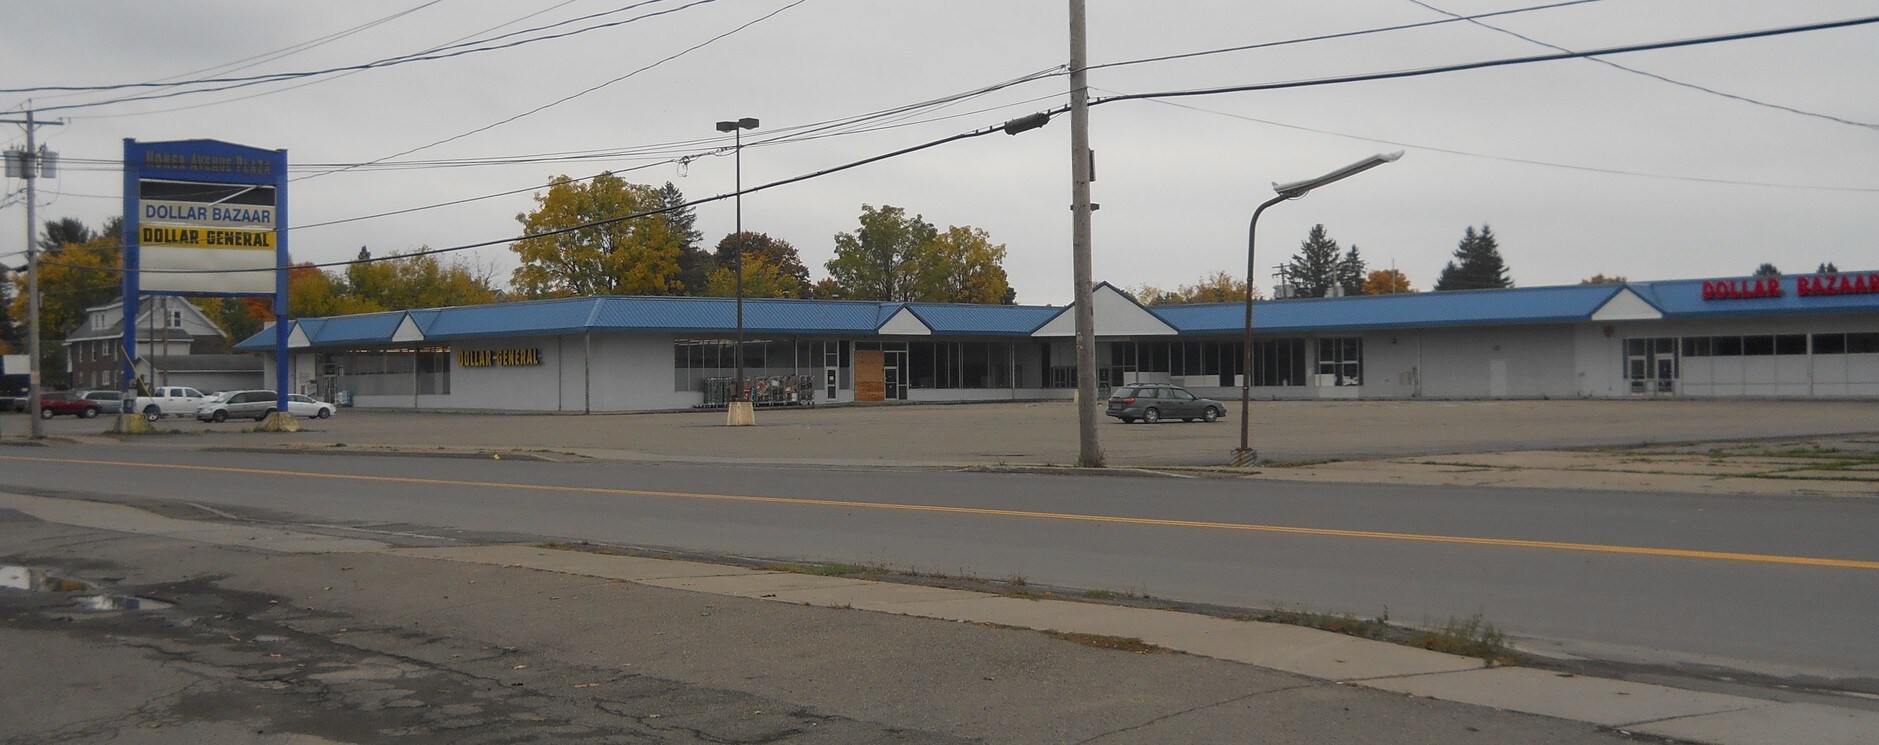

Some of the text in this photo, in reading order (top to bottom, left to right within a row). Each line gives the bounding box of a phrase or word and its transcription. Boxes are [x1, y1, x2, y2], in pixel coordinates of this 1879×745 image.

[146, 204, 271, 223] DOLLAR BAZAAR
[143, 227, 269, 247] DOLLAR GENERAL
[1702, 277, 1781, 300] DOLLAR
[457, 348, 539, 367] DOLLAR GENERAL
